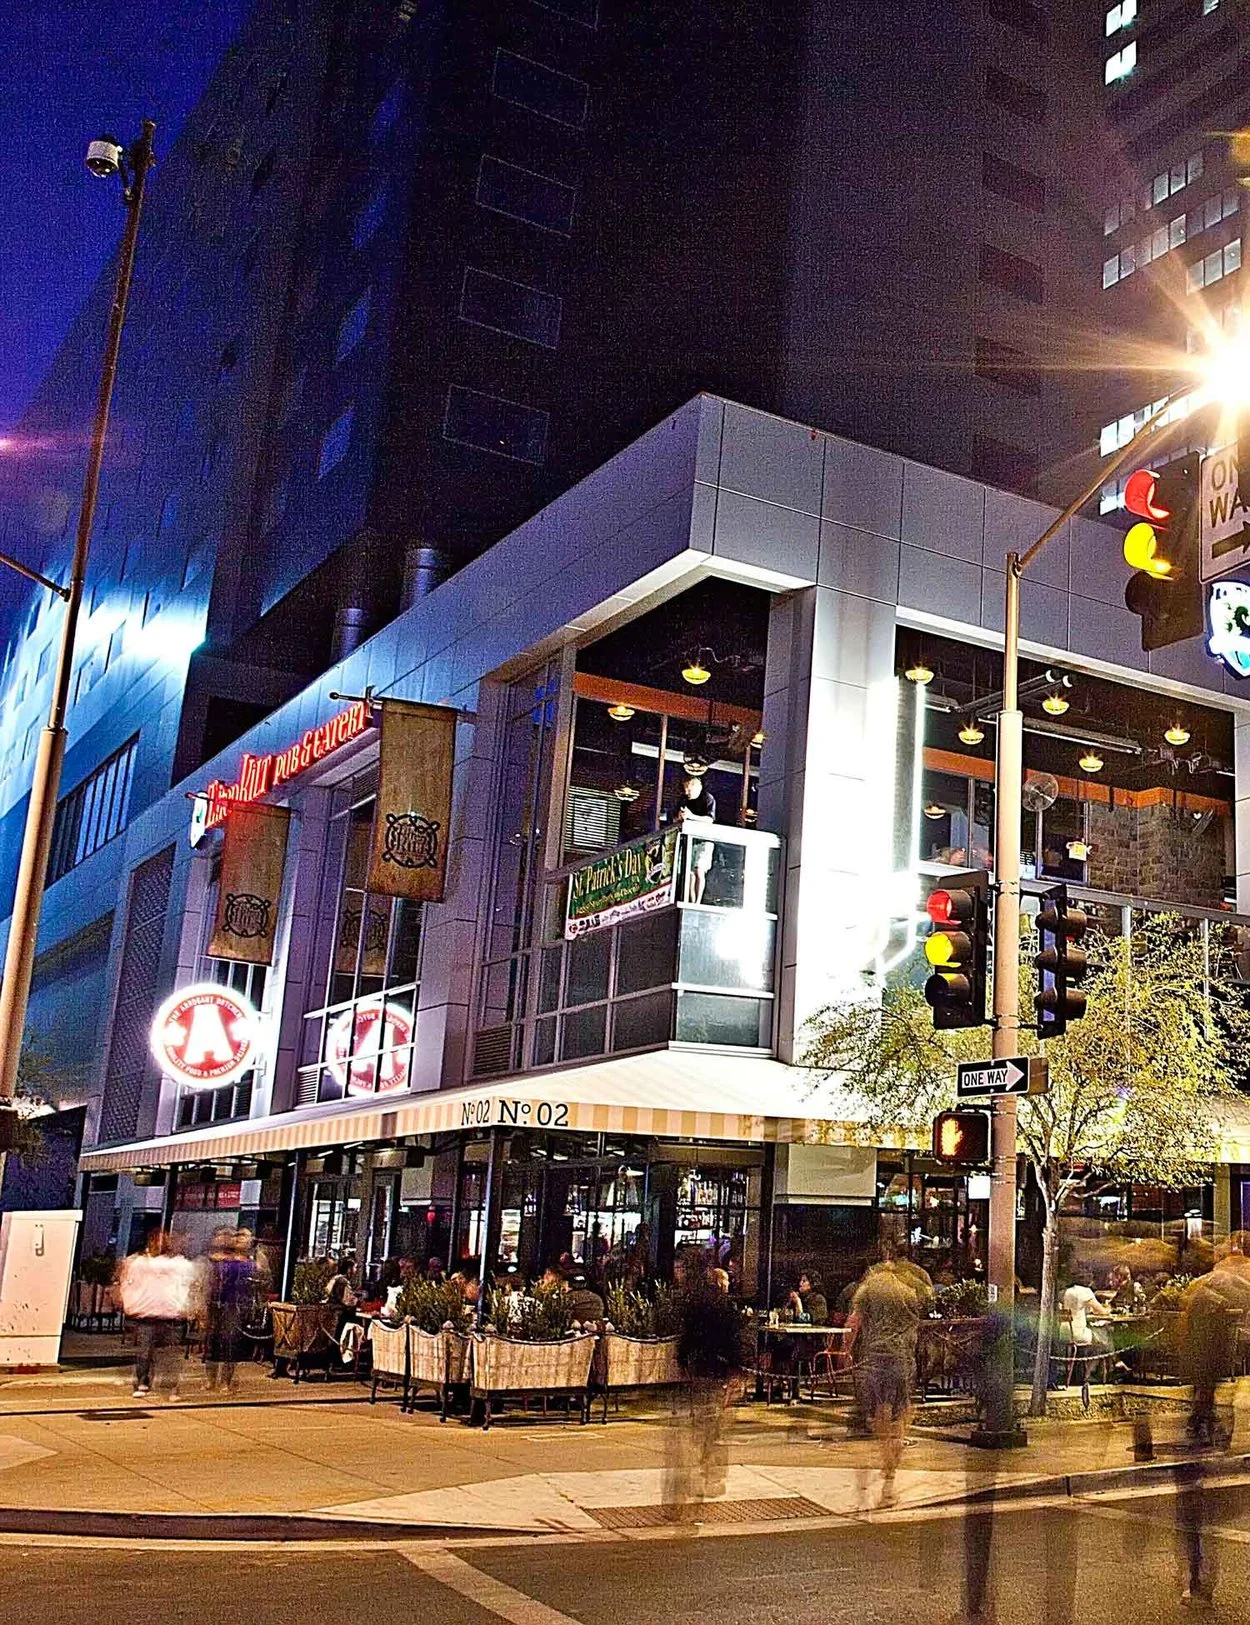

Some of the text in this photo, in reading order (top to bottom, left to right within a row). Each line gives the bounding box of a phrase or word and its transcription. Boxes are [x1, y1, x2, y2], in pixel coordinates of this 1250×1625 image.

[1211, 454, 1239, 491] ON
[1209, 487, 1248, 529] WA
[273, 744, 300, 785] PUB
[963, 1069, 1008, 1087] ONE WAY
[476, 1099, 490, 1124] 02
[537, 1102, 569, 1127] 02
